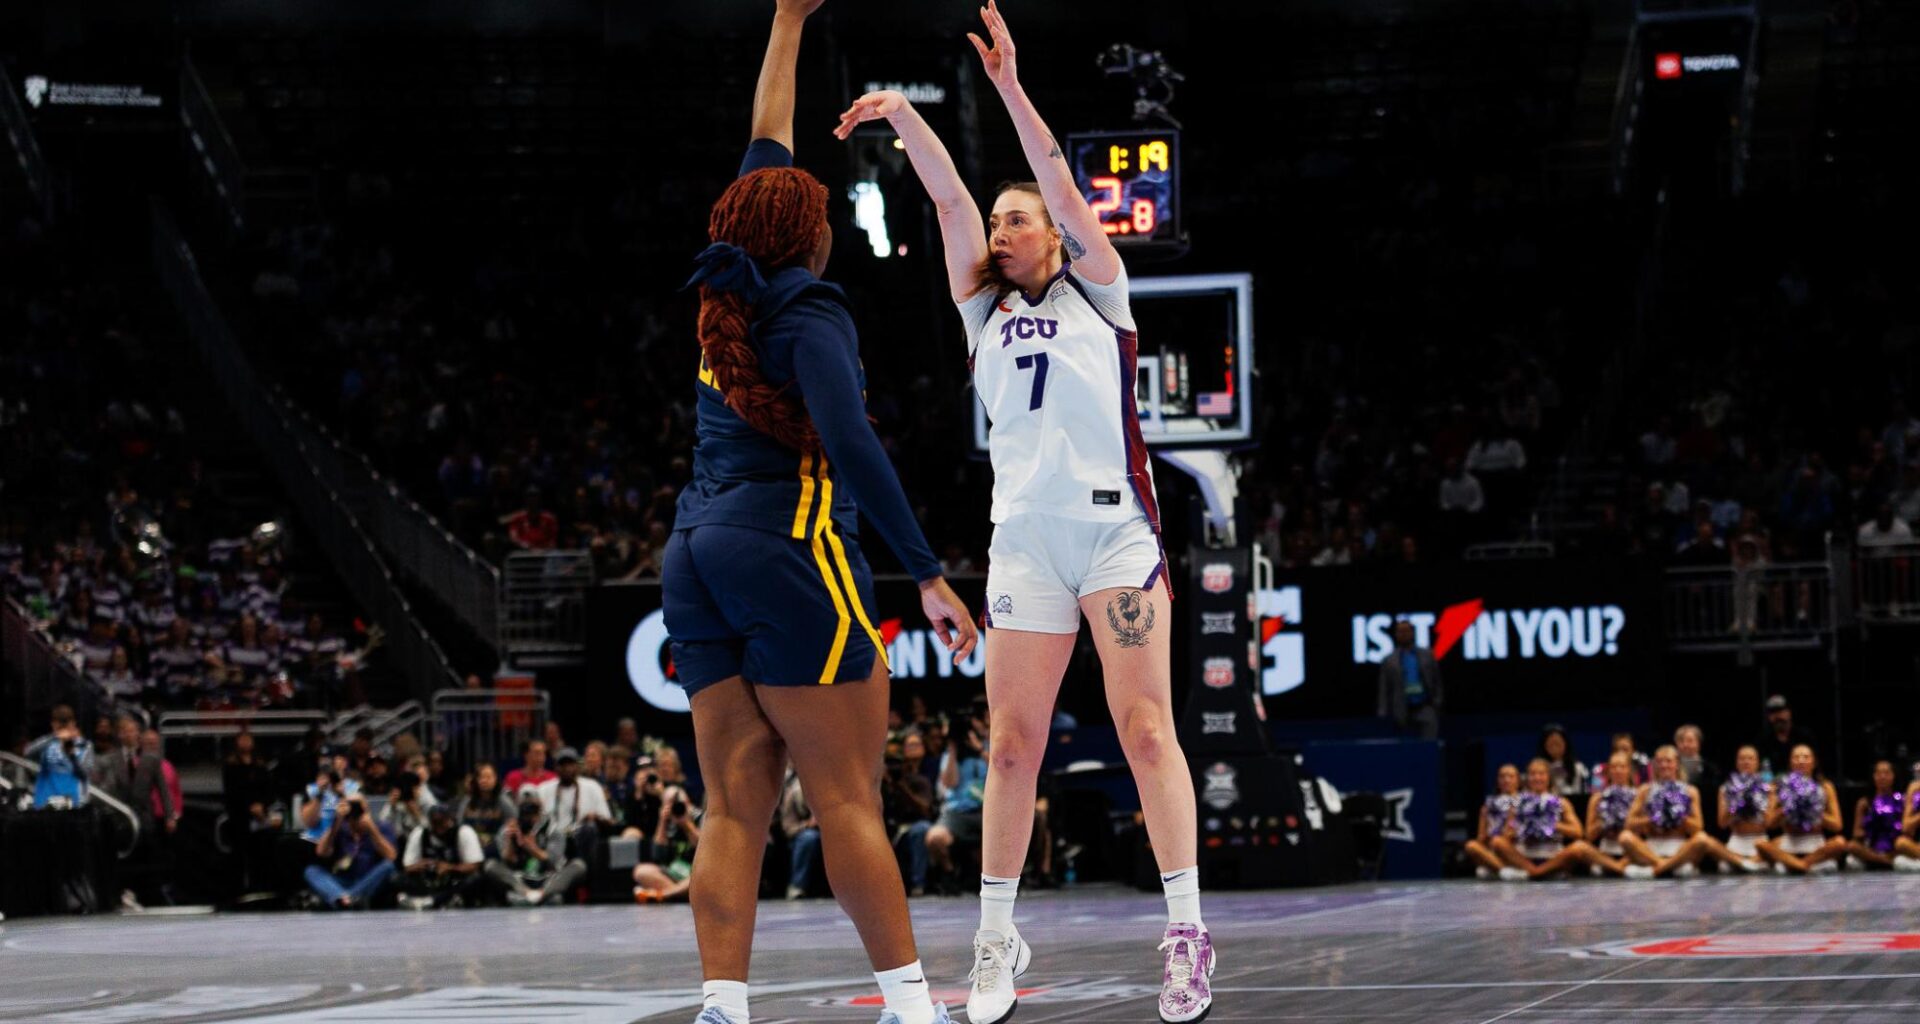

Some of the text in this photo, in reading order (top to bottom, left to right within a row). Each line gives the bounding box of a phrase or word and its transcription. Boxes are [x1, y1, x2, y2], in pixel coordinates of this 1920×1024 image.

[1109, 141, 1168, 174] 1:19
[1000, 315, 1058, 349] TCU
[1015, 352, 1049, 411] 7
[1352, 604, 1625, 664] IS T IN YOU?
